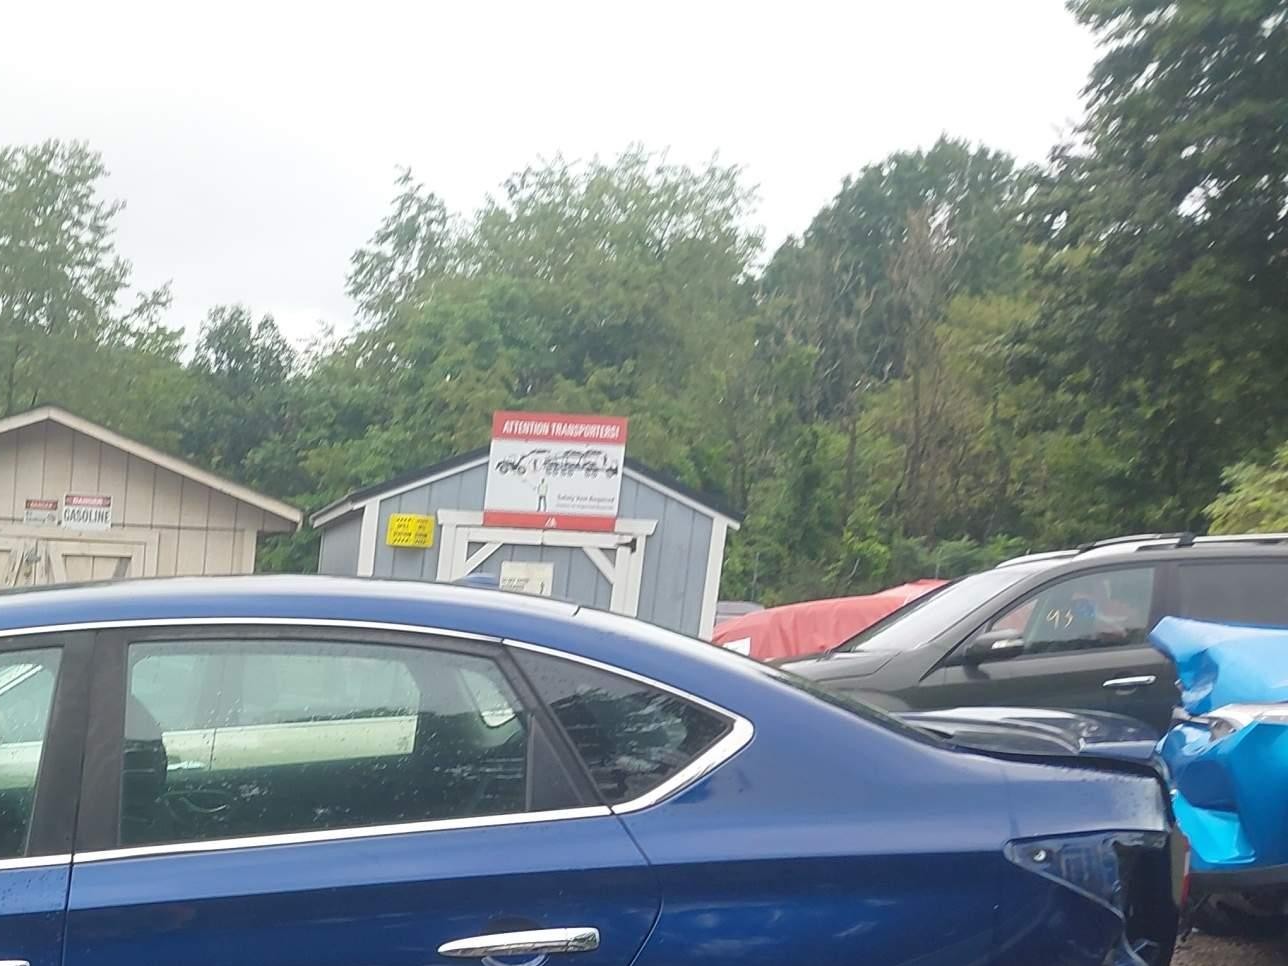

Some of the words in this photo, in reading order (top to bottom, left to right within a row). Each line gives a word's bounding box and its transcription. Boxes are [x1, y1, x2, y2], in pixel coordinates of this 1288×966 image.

[502, 420, 550, 434] ATTENTION
[551, 421, 620, 440] TRANSPORTERS!
[64, 509, 110, 523] GASOLINE
